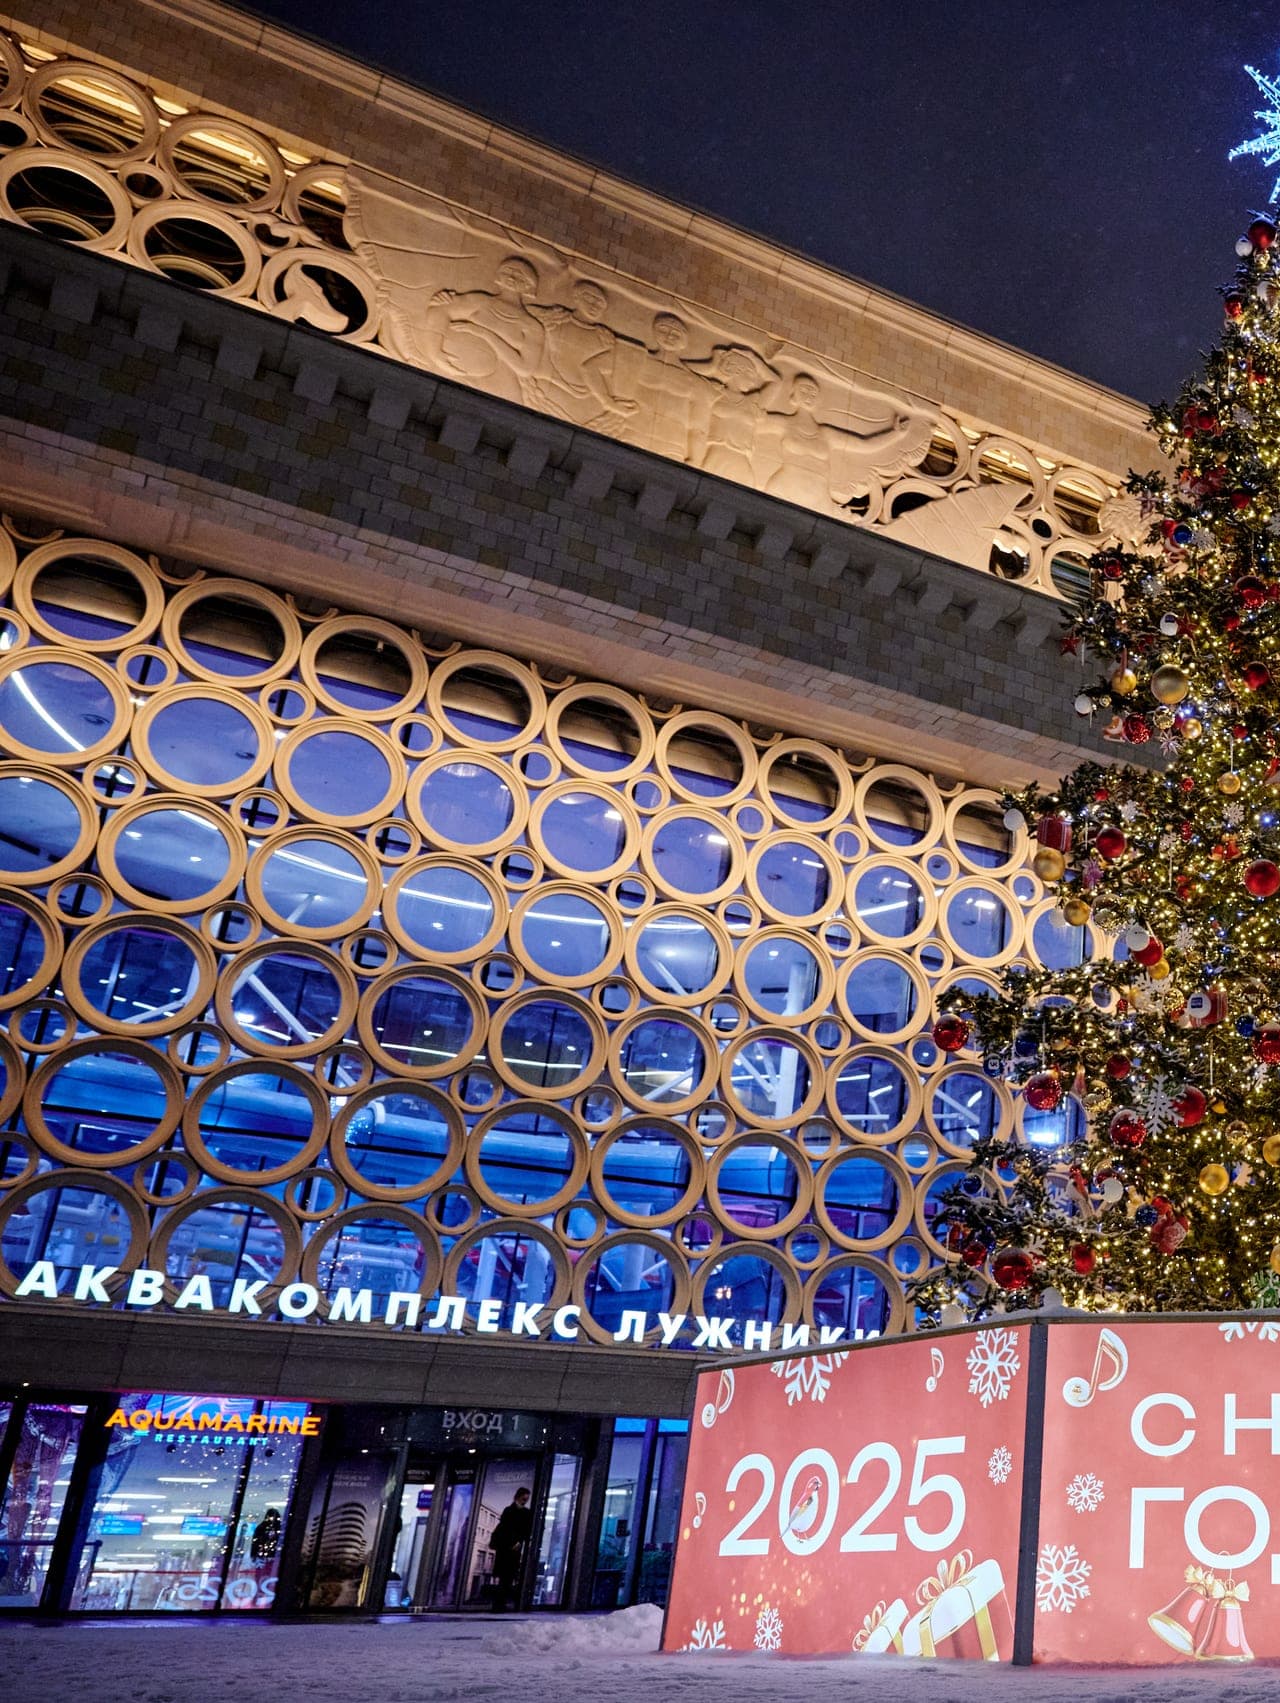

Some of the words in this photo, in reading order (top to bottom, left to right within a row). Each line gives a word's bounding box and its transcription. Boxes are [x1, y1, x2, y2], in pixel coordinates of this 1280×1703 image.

[15, 1260, 582, 1339] АКВАКОМПЛЕКС
[104, 1409, 321, 1436] AQUAMARINE
[154, 1433, 268, 1446] RESTAURANT
[442, 1411, 504, 1434] ВХОД
[511, 1414, 520, 1431] 1
[1130, 1392, 1197, 1457] С
[719, 1435, 967, 1556] 2025
